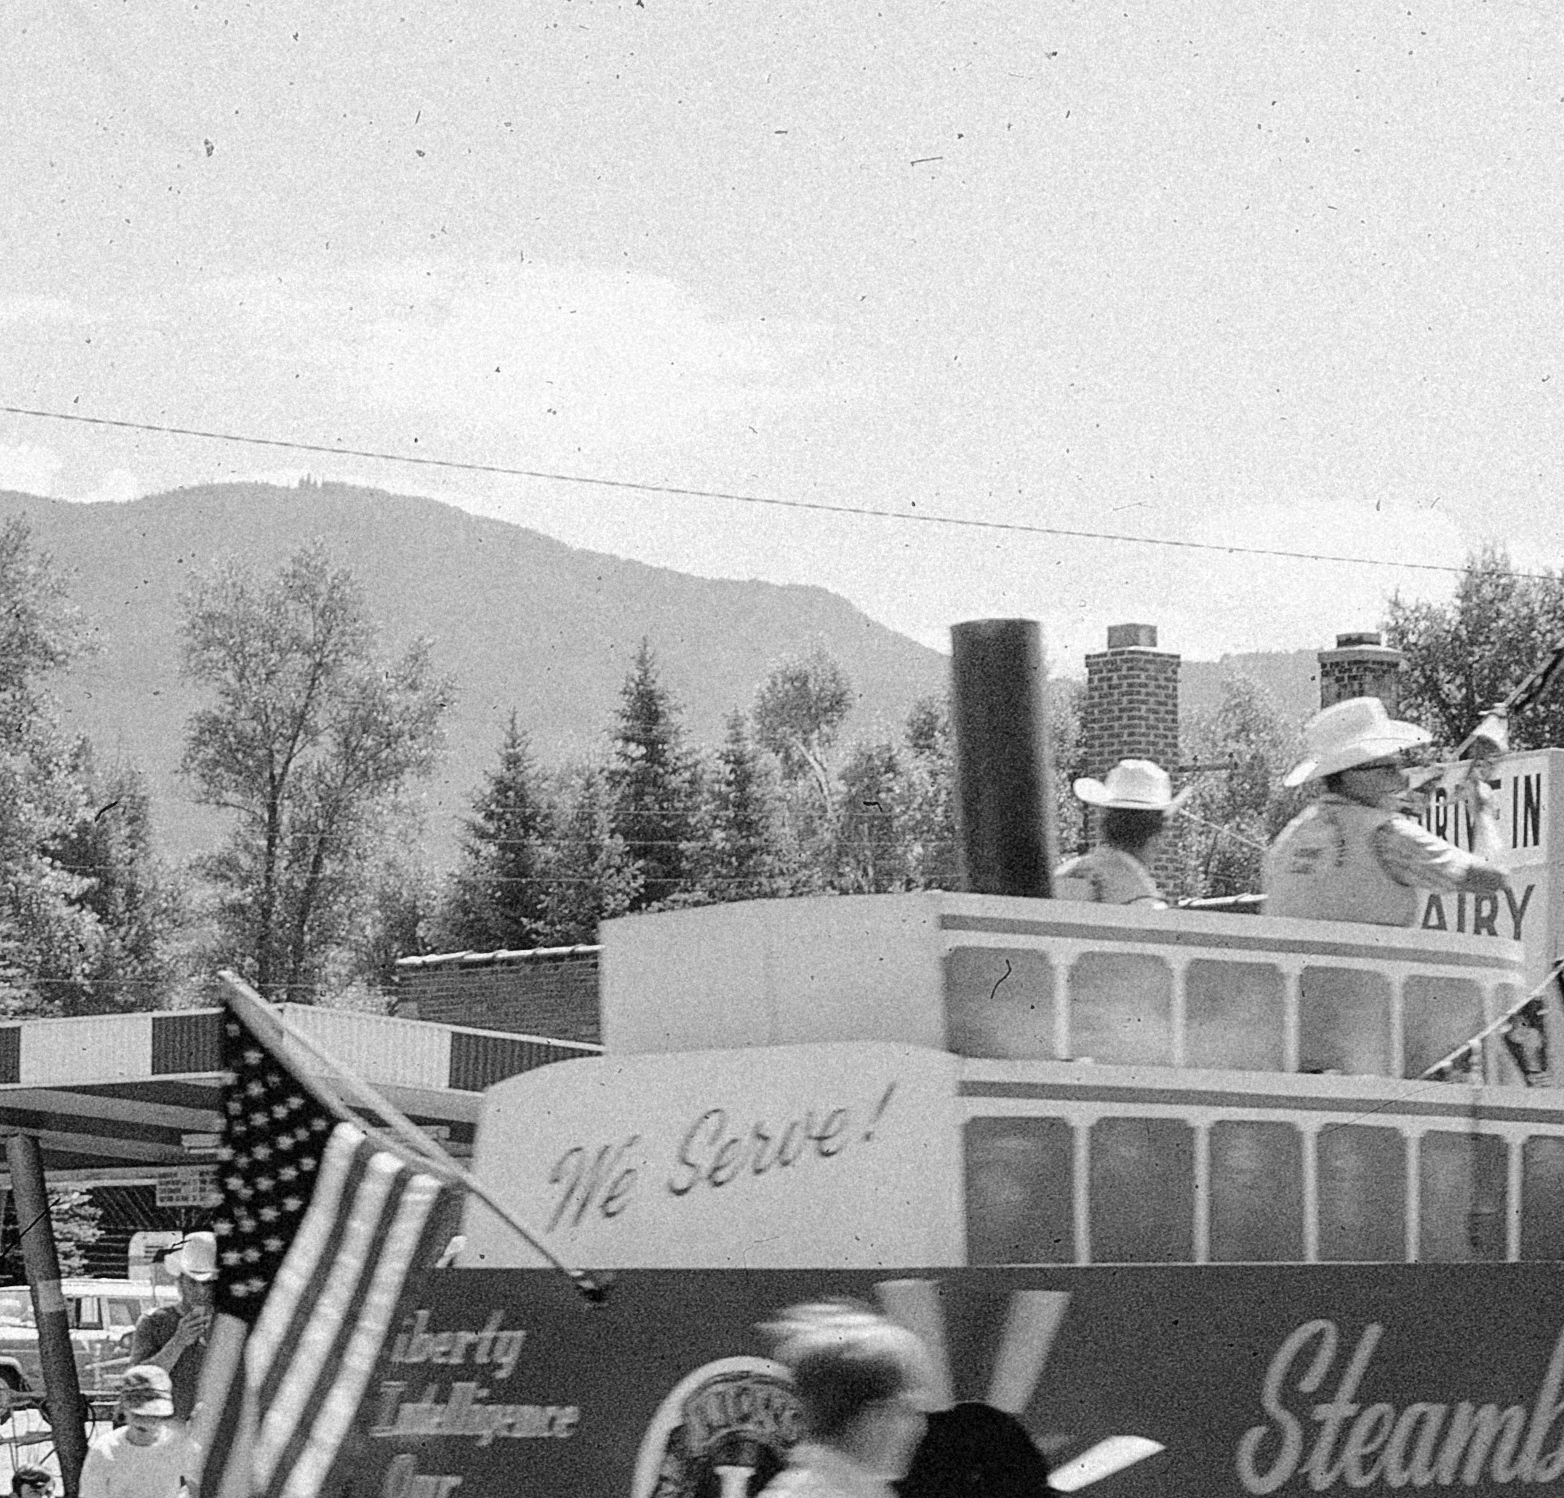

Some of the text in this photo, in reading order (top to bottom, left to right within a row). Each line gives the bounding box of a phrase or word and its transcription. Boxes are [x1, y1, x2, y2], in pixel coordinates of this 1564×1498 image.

[1512, 773, 1541, 849] IN
[1421, 884, 1536, 941] AIRY
[546, 1081, 898, 1234] We Serve!
[389, 1309, 527, 1379] iberty
